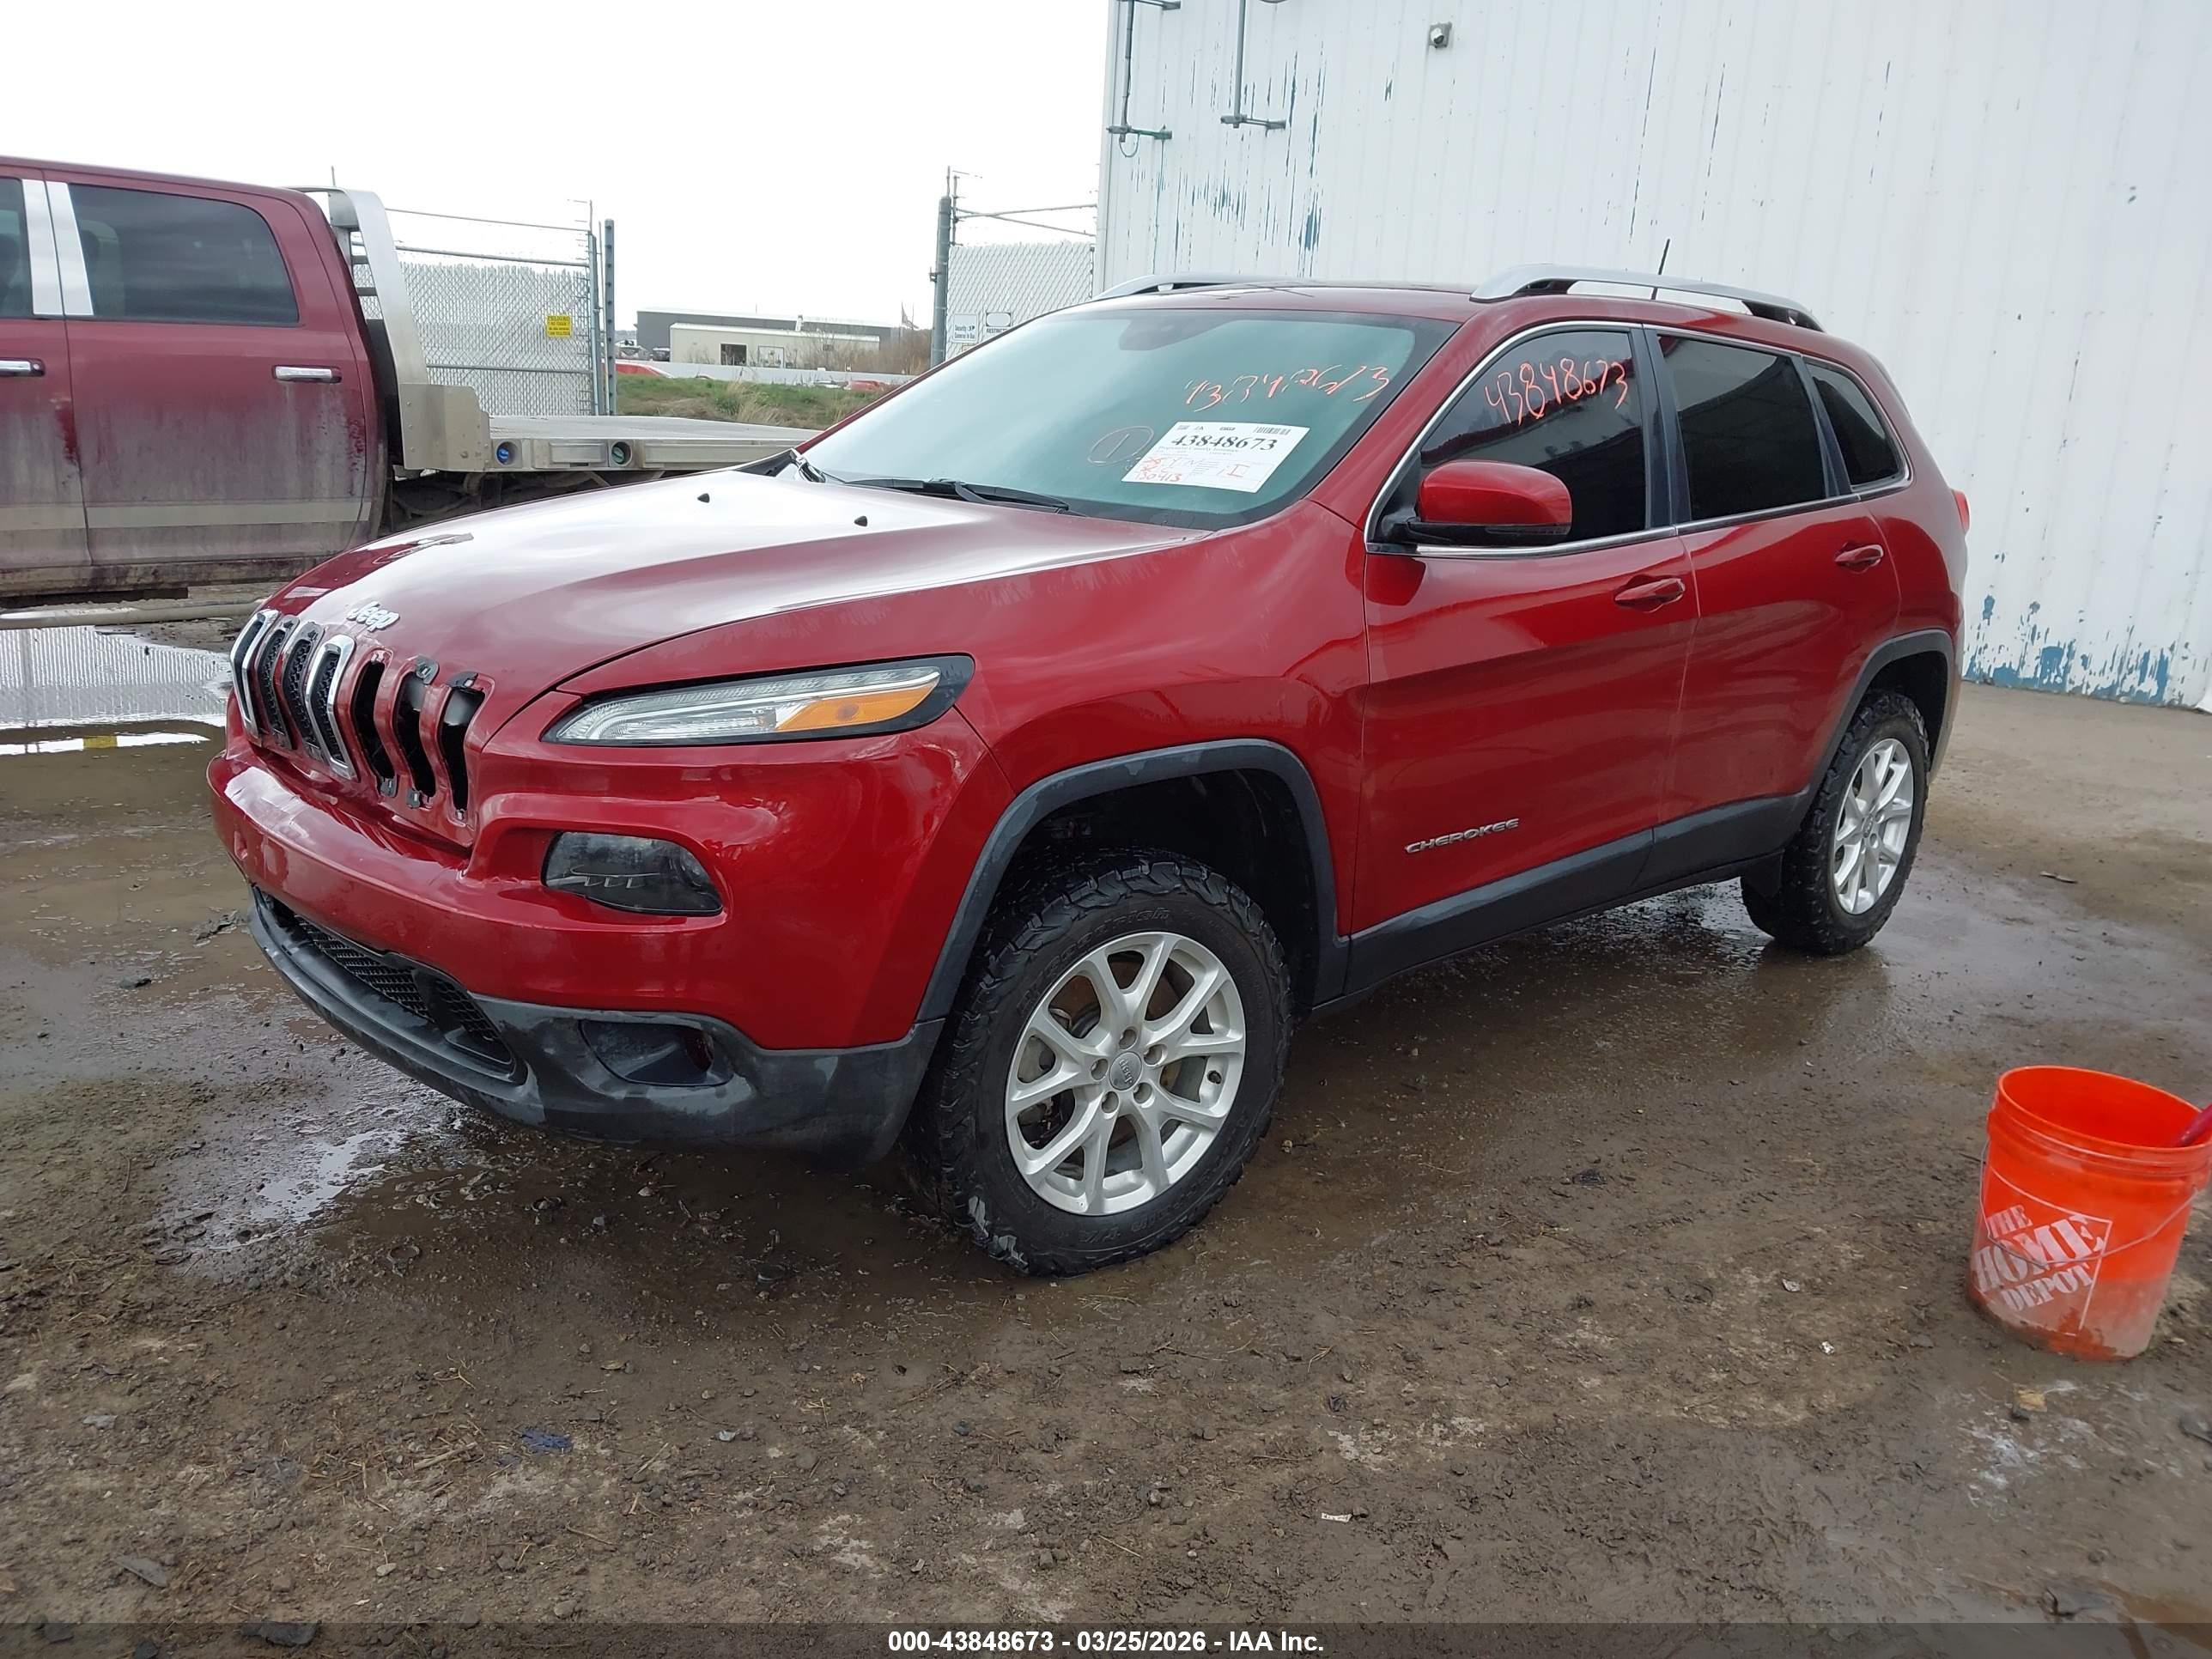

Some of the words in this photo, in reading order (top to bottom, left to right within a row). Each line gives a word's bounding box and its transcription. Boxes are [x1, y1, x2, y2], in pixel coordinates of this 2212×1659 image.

[1485, 357, 1629, 427] 43848673
[1171, 434, 1278, 452] 43848673
[346, 600, 400, 633] Jeep
[1404, 818, 1520, 854] CHEROKEE
[1118, 1059, 1134, 1085] Jeep
[1985, 1204, 2033, 1239] THE
[1974, 1214, 2106, 1292] HOME
[2000, 1262, 2094, 1312] DEPOT
